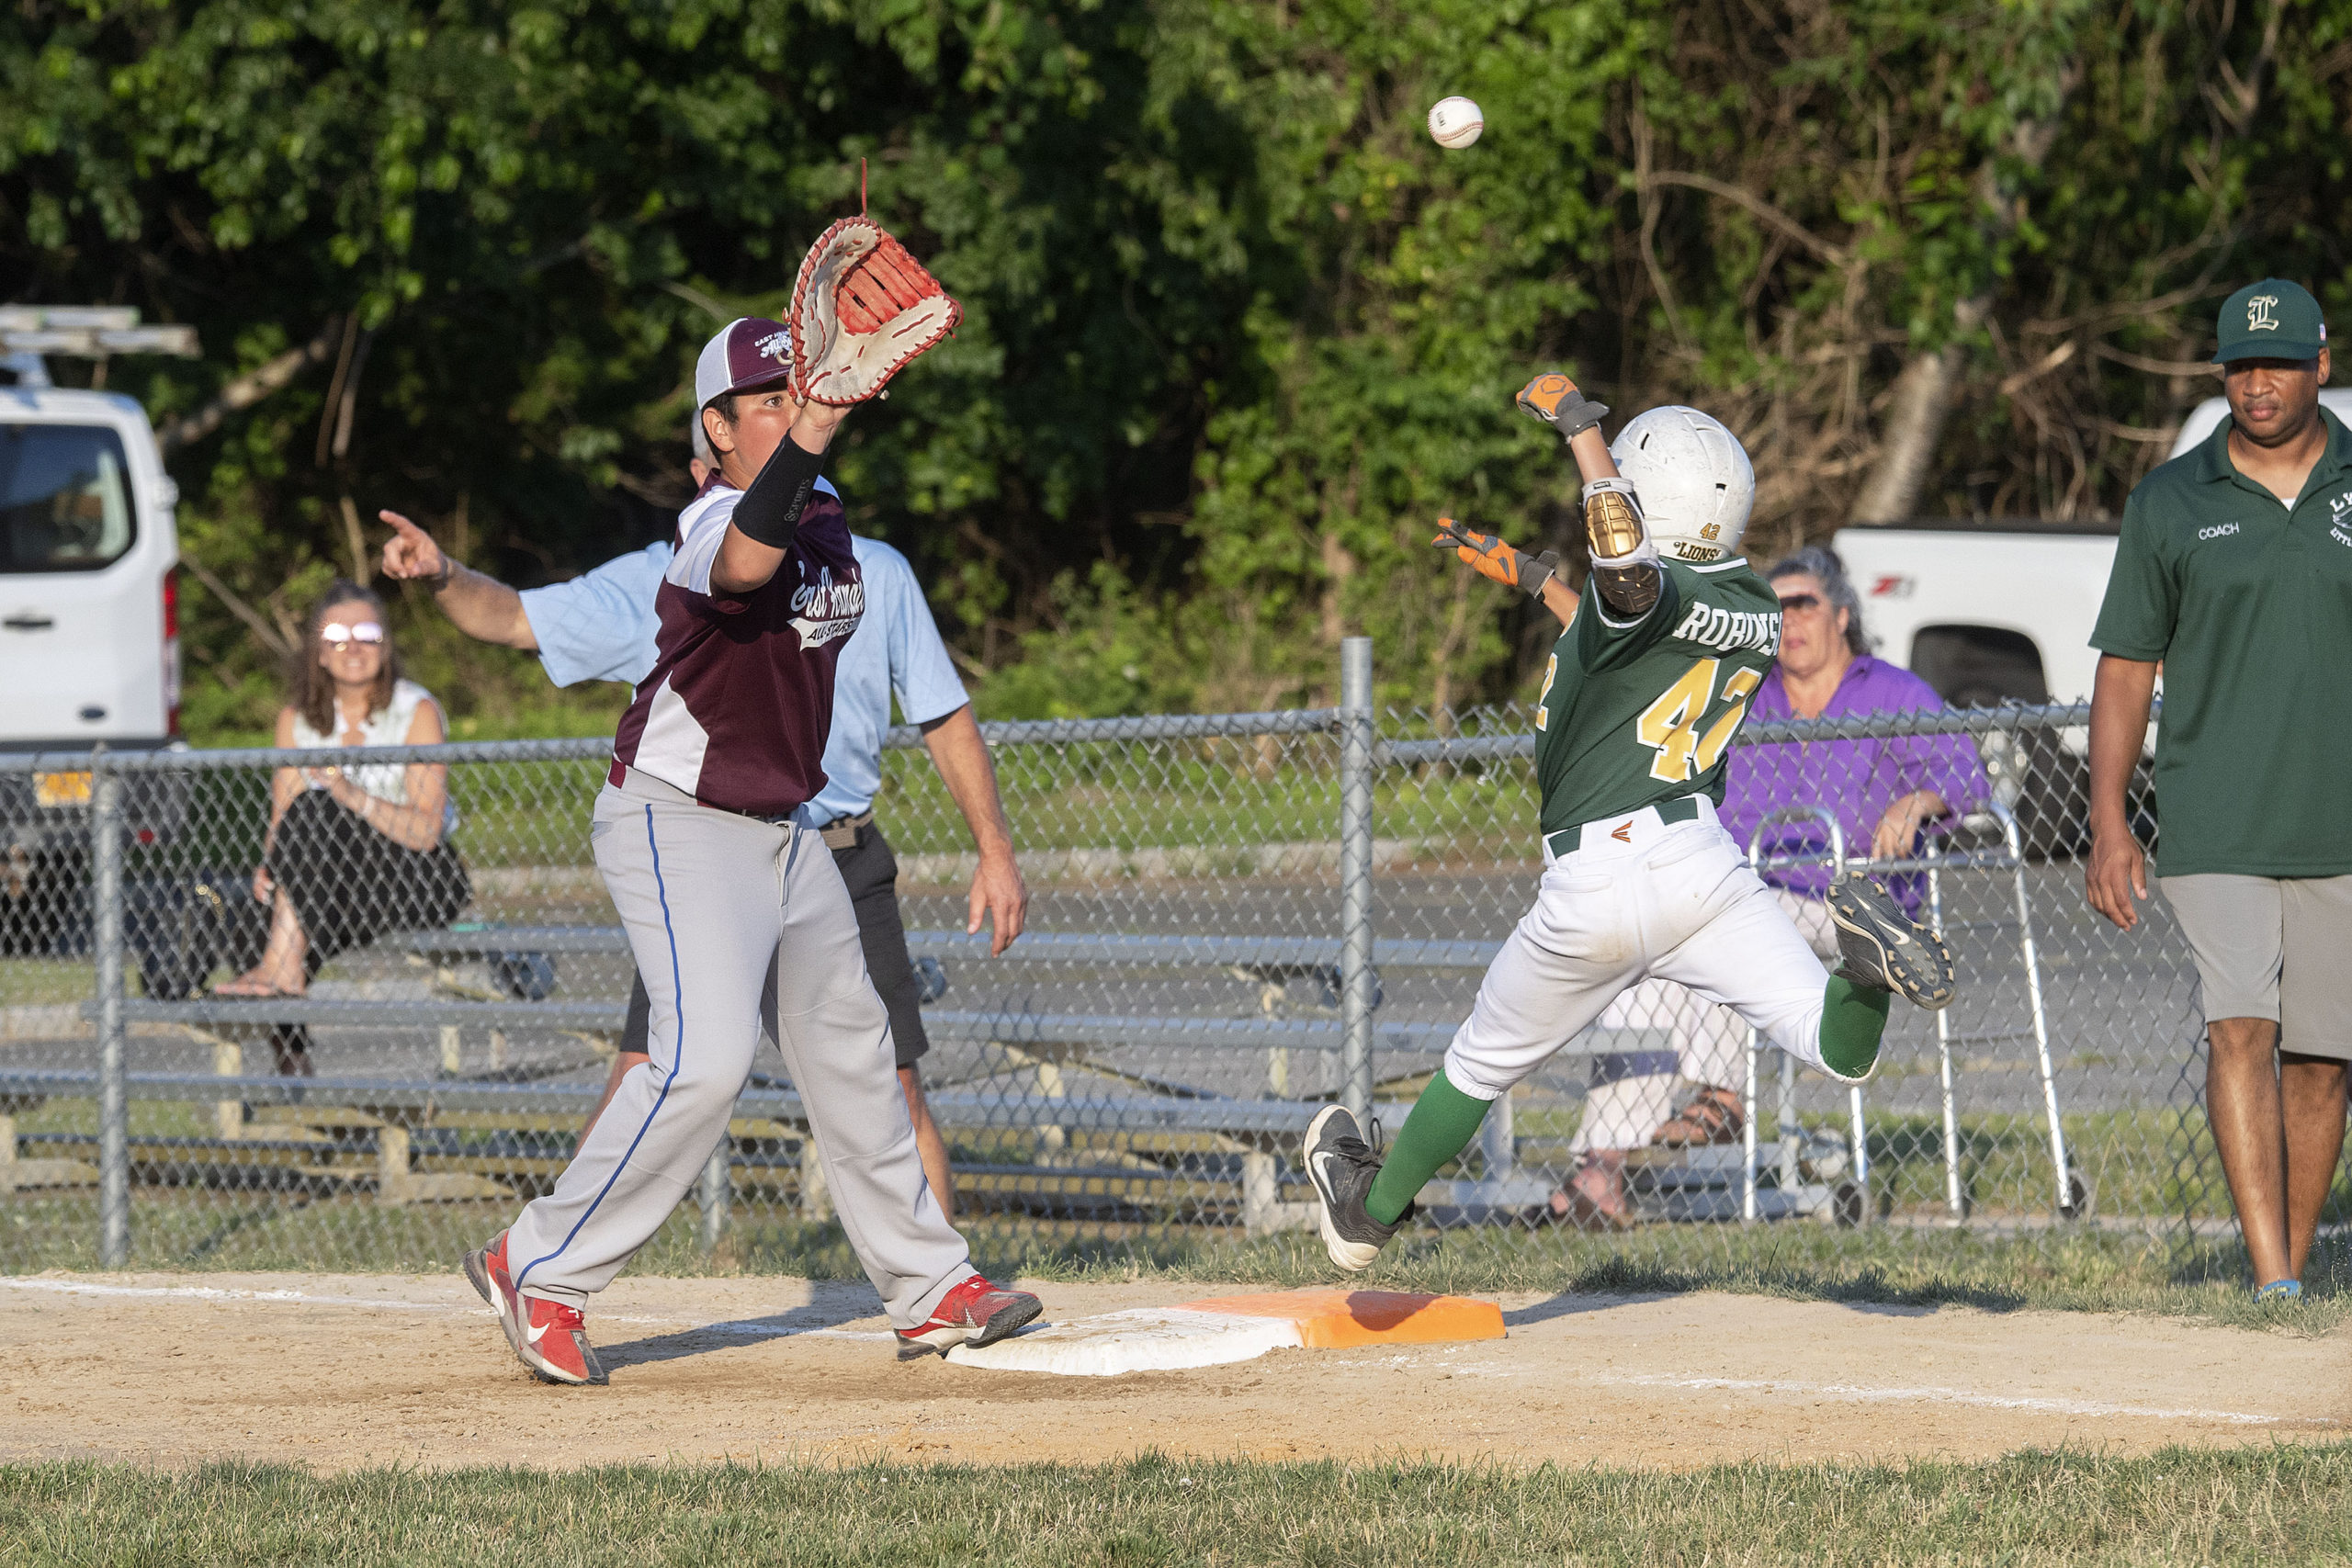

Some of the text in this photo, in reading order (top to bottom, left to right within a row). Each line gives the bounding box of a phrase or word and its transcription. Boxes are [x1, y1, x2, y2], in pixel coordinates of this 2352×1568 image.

[754, 333, 774, 347] EAST
[1700, 522, 1721, 540] 42
[2198, 521, 2240, 540] COACH
[1671, 601, 1783, 657] ROBINS
[1636, 656, 1763, 784] 42
